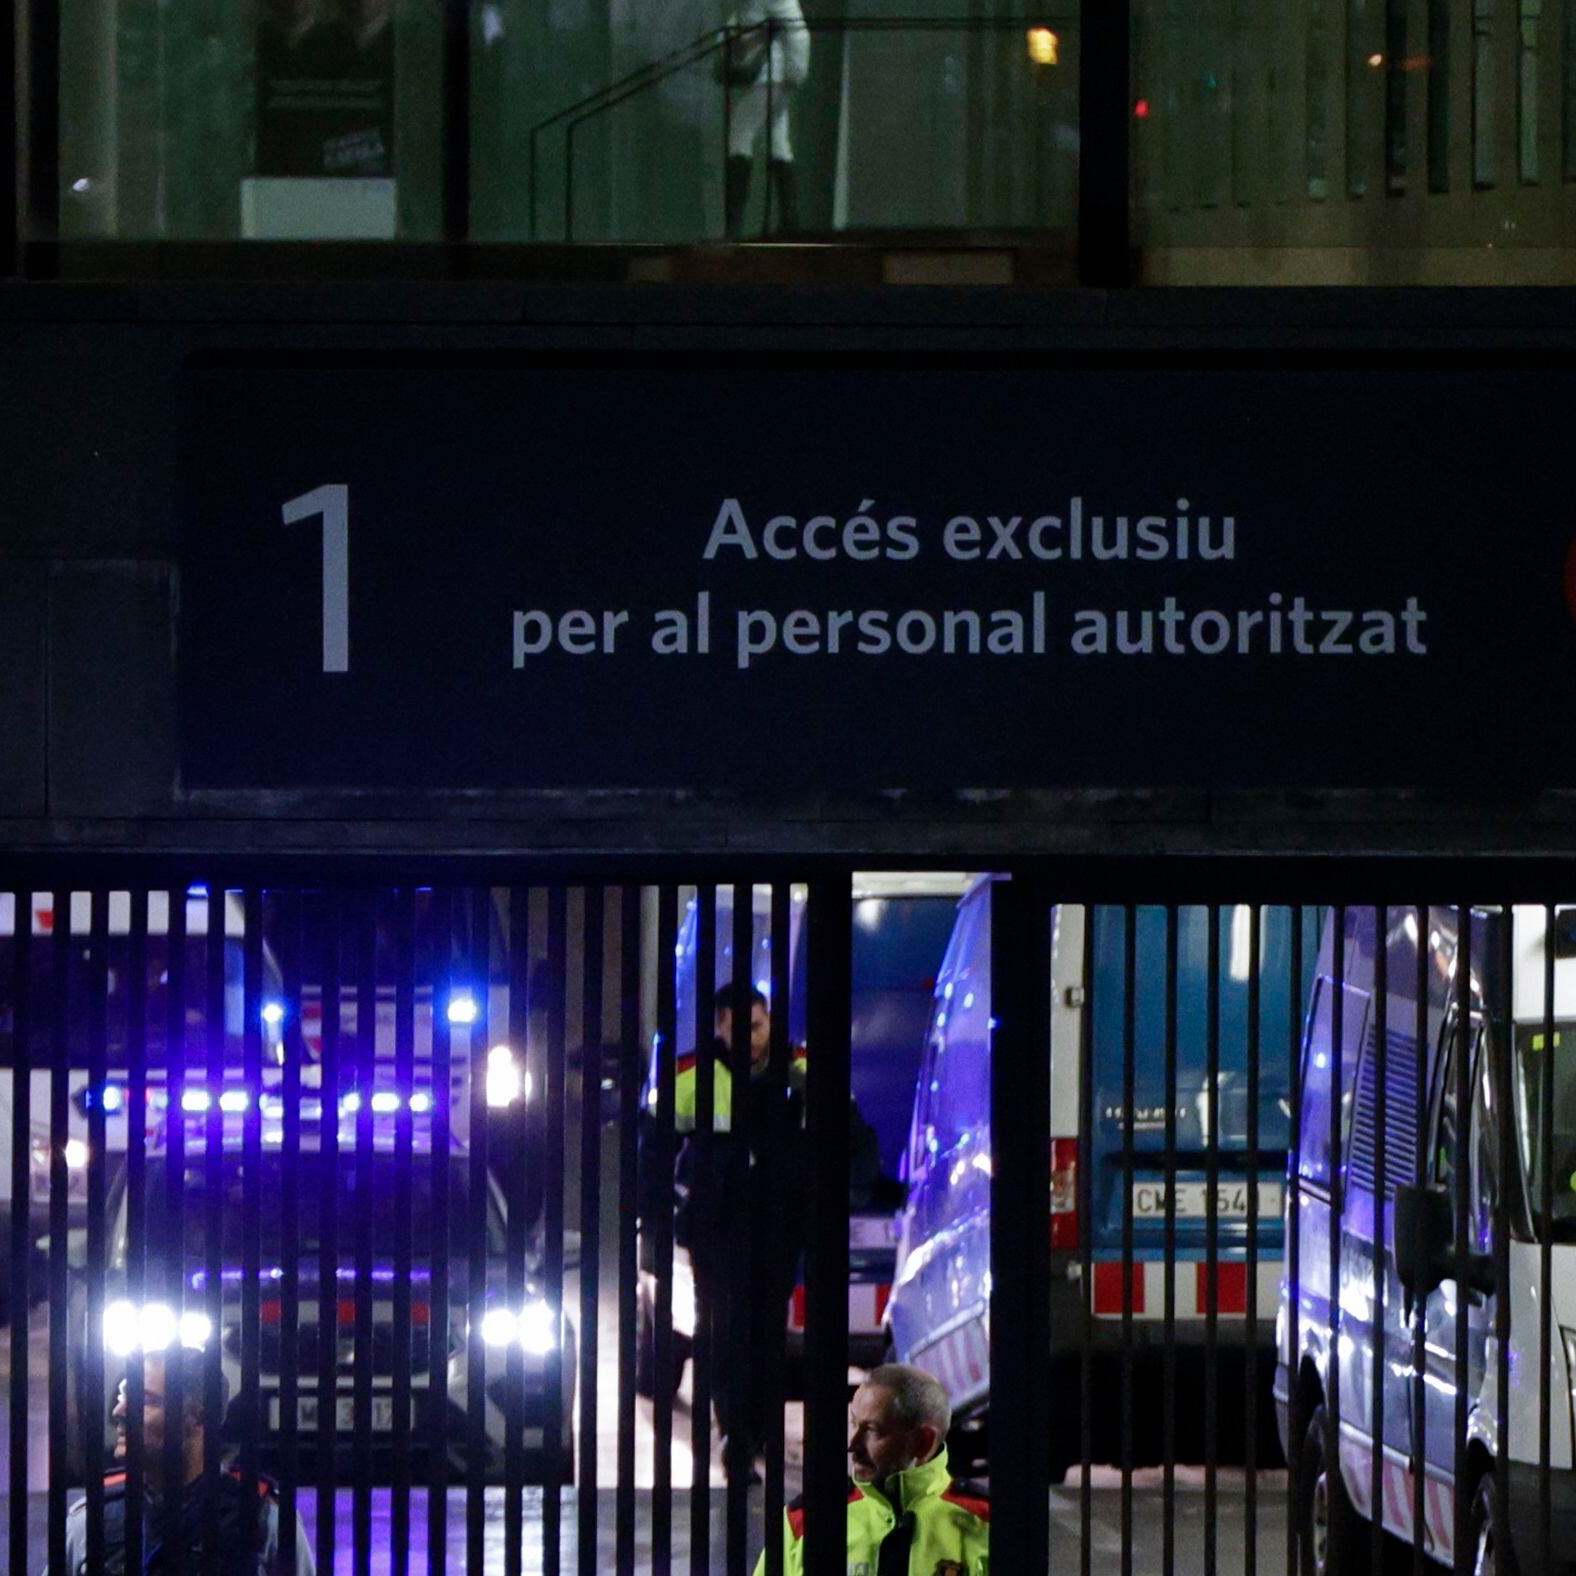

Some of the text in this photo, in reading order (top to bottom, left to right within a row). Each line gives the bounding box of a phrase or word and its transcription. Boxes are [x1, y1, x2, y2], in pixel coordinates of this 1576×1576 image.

[702, 497, 1236, 562] Accés exclusiu
[281, 484, 350, 674] 1
[511, 591, 1428, 670] per al personal autoritzat
